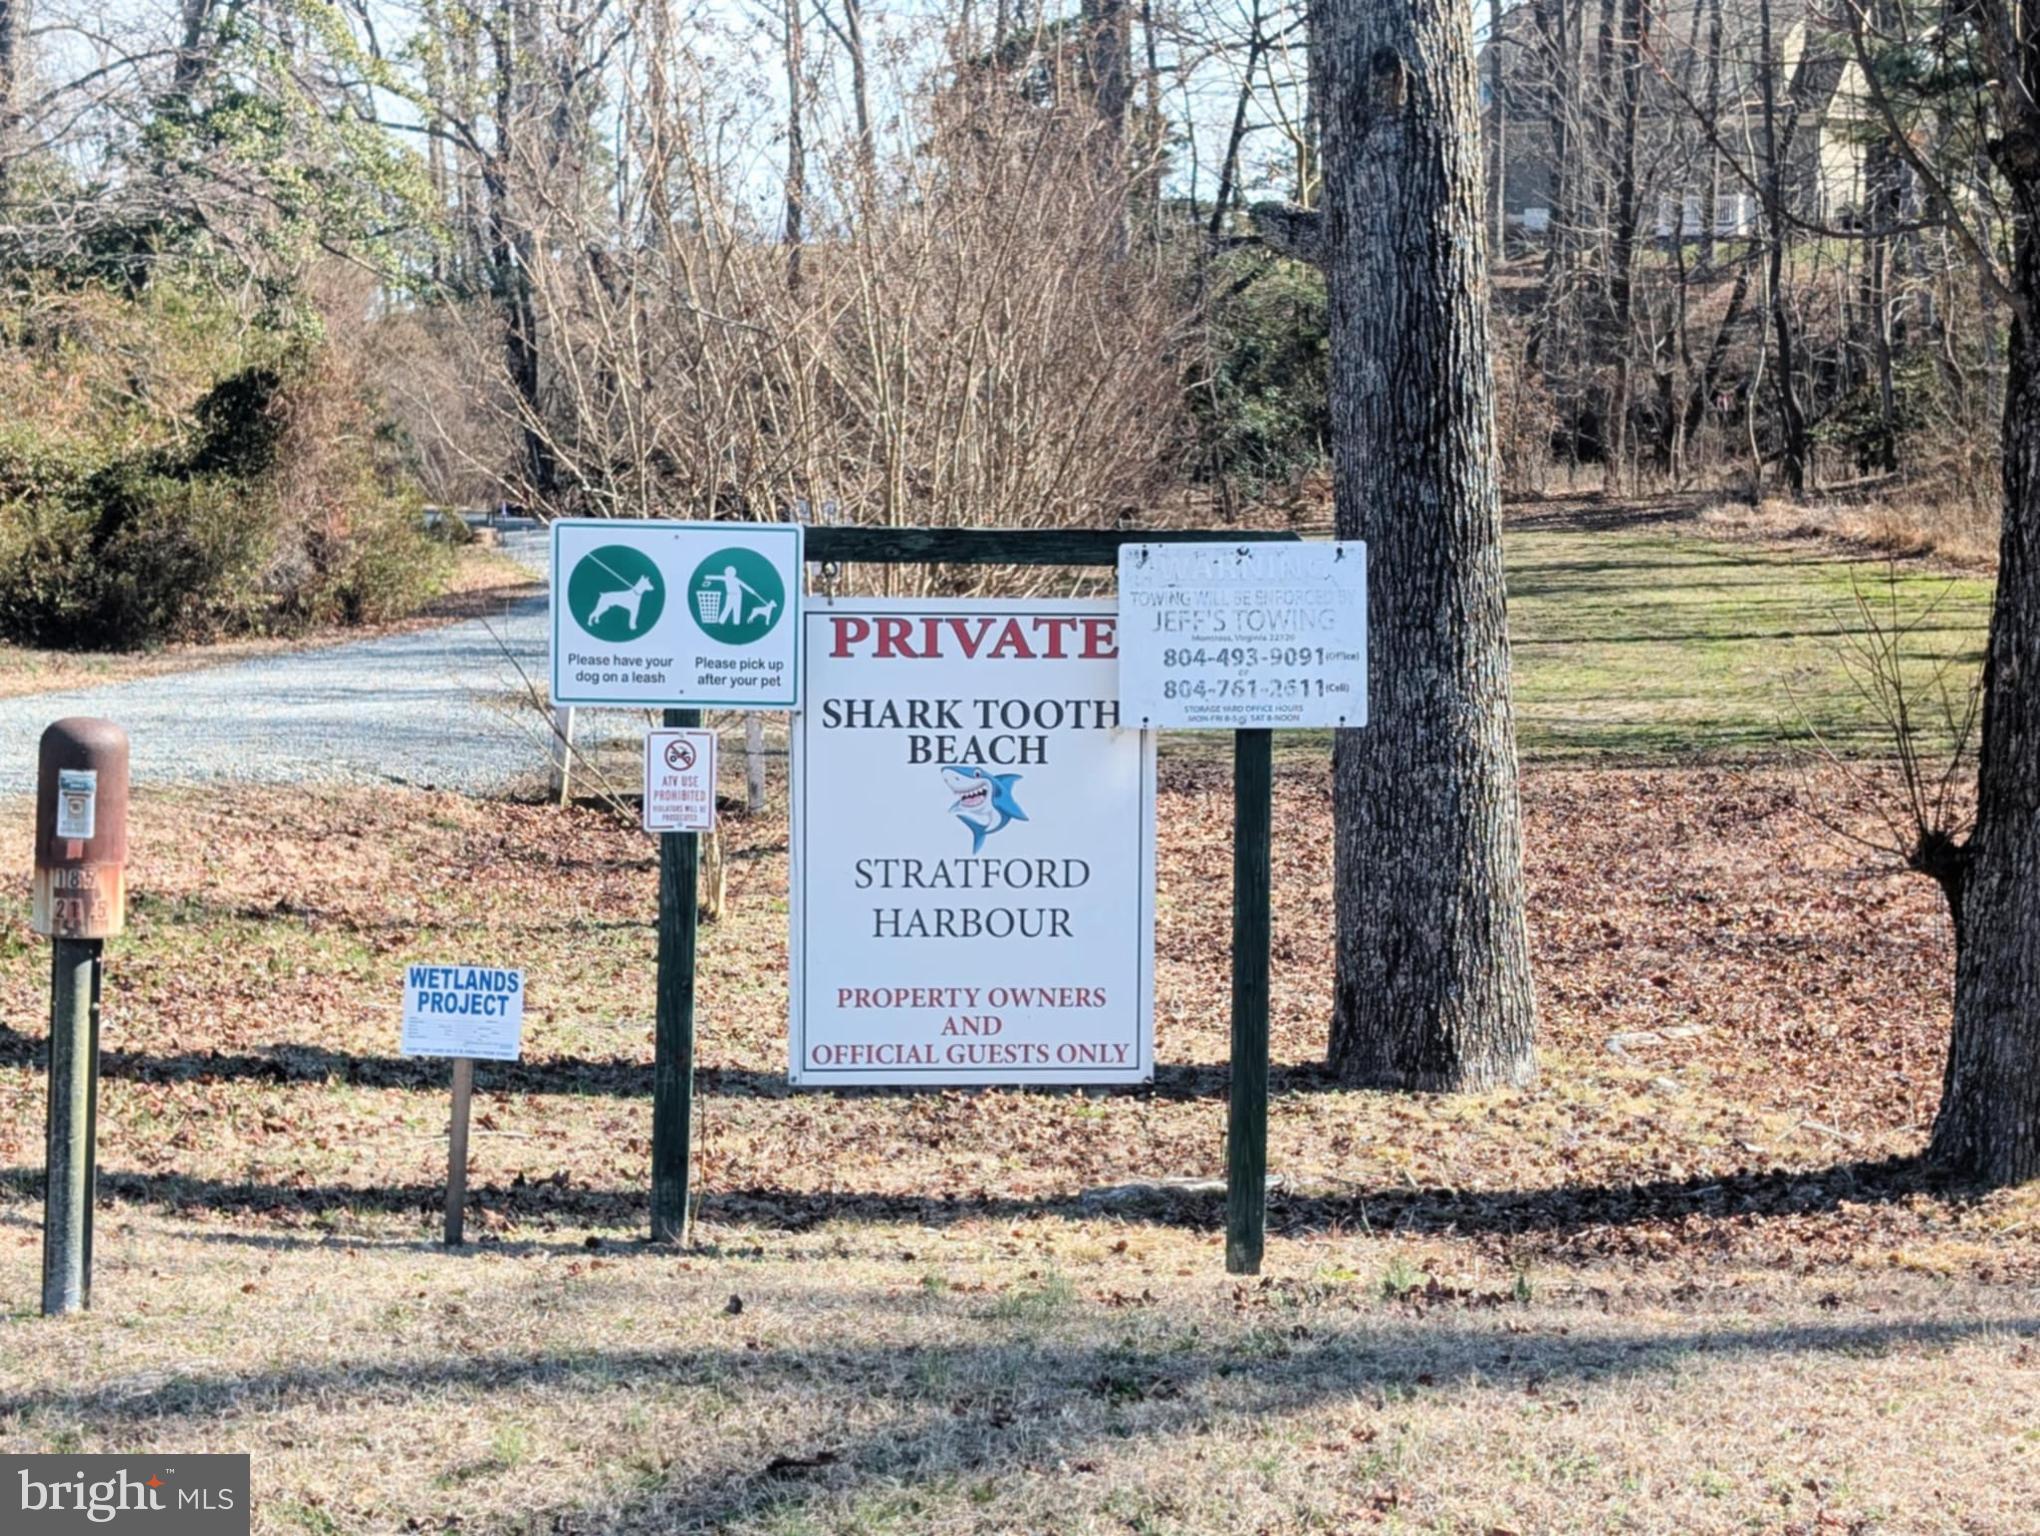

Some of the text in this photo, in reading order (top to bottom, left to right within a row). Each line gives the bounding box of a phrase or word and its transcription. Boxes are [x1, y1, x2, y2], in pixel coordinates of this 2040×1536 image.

[1130, 591, 1191, 606] TOWING
[1152, 609, 1336, 632] JEFF'S TOWING
[829, 617, 1119, 659] PRIVATE
[568, 653, 673, 670] Please have your
[695, 657, 784, 674] Please pick up
[1163, 647, 1324, 667] 804-493-9091
[576, 671, 665, 685] dog on a leash
[697, 674, 781, 688] after your pet
[1163, 678, 1324, 699] 804-761-2611
[822, 699, 1119, 729] SHARK TOOTH
[907, 735, 1048, 765] BEACH
[662, 776, 699, 787] ATV USE
[654, 790, 705, 801] PROHIBITED
[854, 858, 1091, 889] STRATFORD
[872, 908, 1074, 938] HARBOUR
[409, 967, 519, 993] WETLANDS
[417, 991, 510, 1017] PROJECT
[837, 987, 1107, 1008] PROPERTY OWNERS
[940, 1015, 1002, 1036] AND
[811, 1042, 1130, 1065] OFFICIAL GUESTS ONLY
